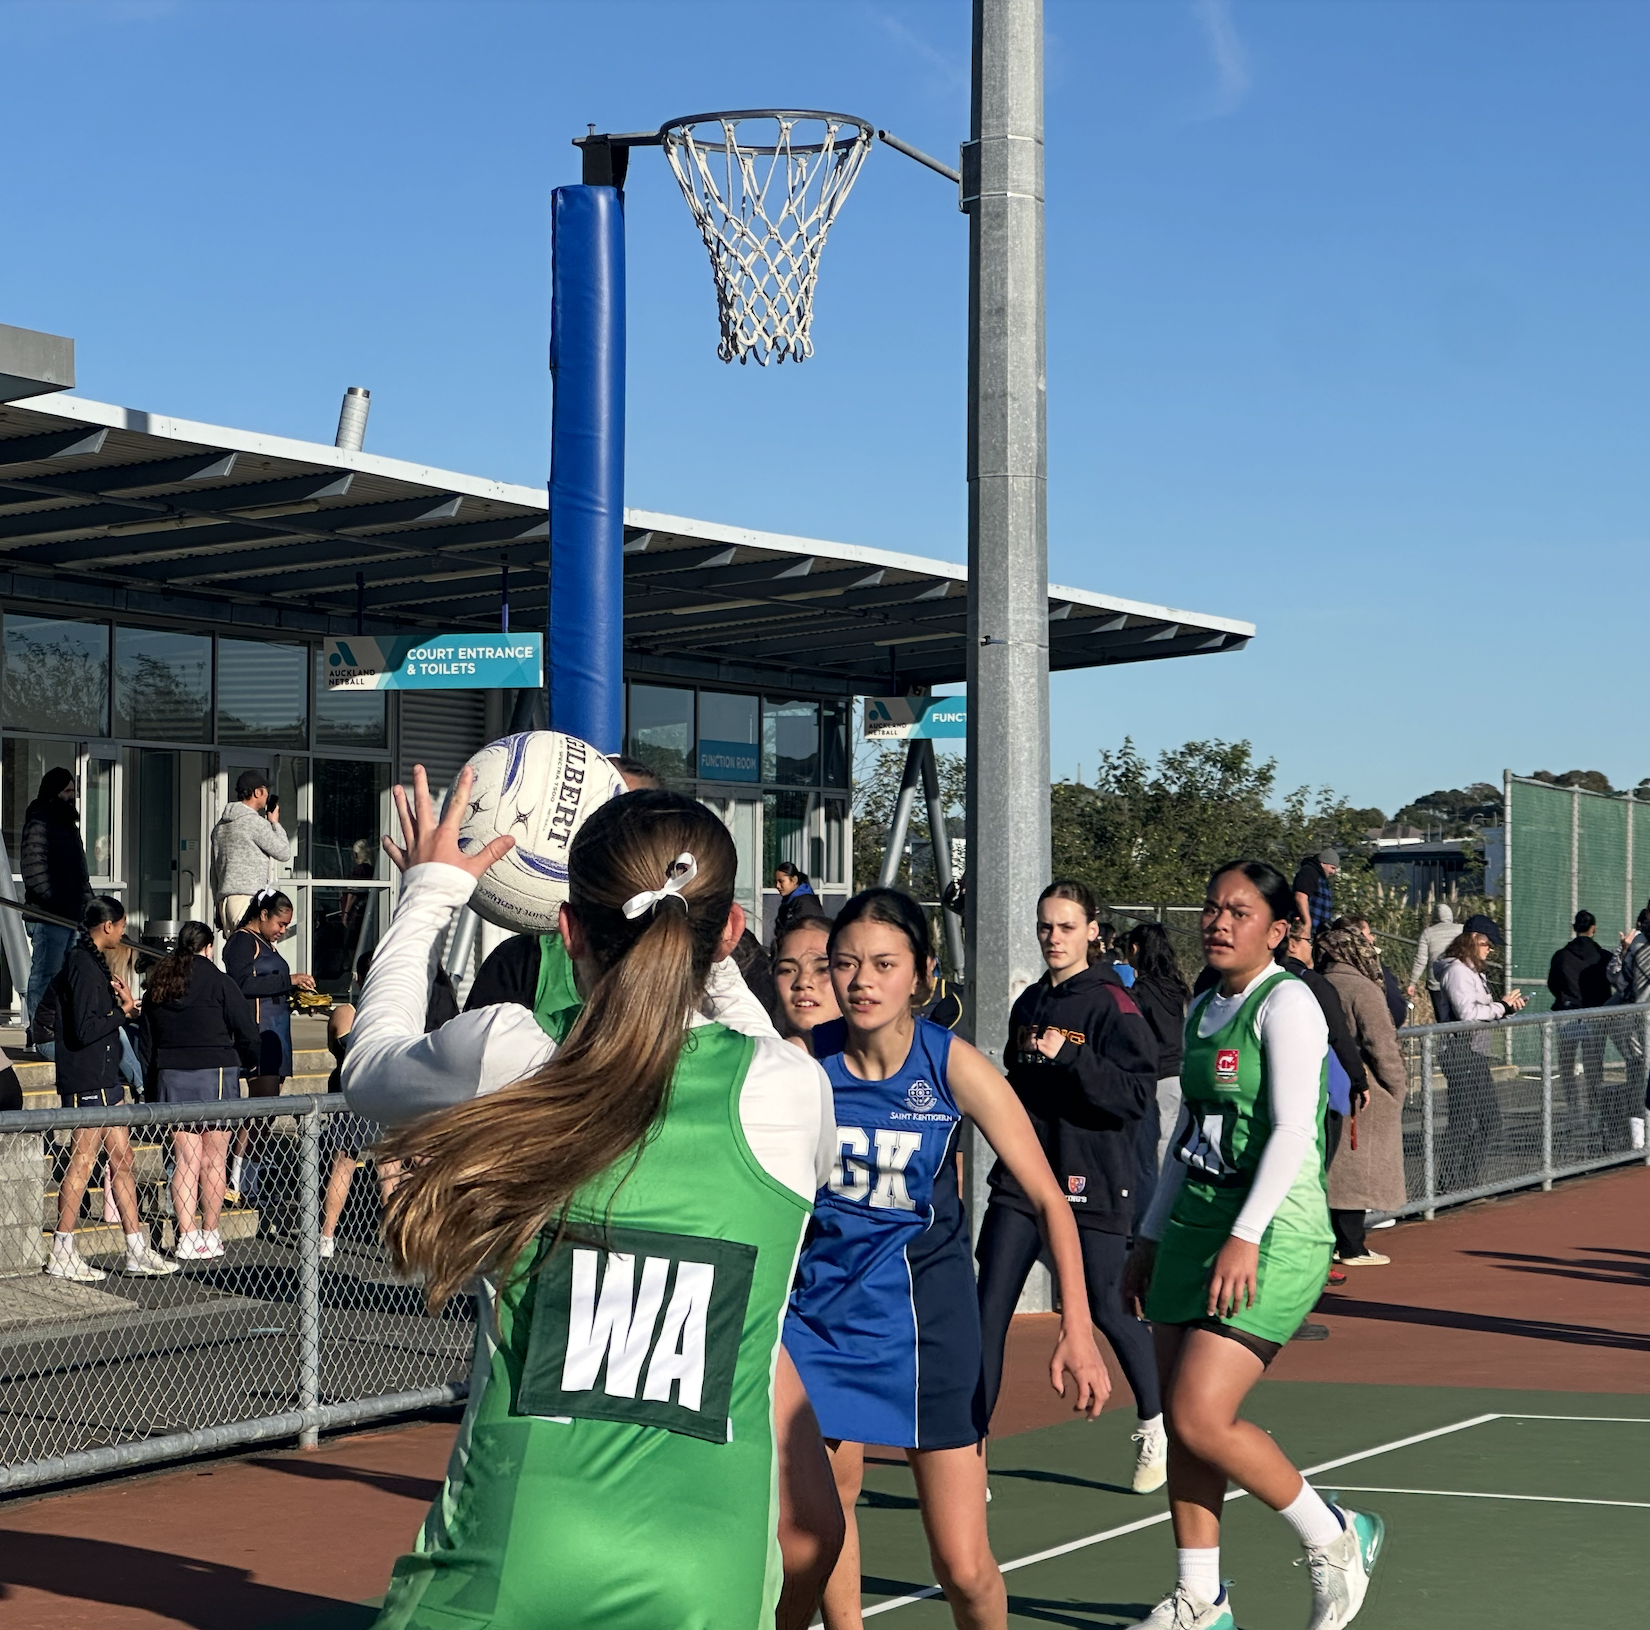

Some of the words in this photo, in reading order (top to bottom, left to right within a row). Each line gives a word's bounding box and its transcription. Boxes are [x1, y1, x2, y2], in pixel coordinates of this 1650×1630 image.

[407, 647, 455, 661] COURT
[458, 646, 534, 660] ENTRANCE
[329, 669, 376, 677] AUCKLAND
[406, 663, 416, 676] &
[420, 662, 476, 675] TOILETS
[328, 678, 365, 686] NETBALL
[554, 750, 564, 782] SPECTRA
[701, 754, 735, 769] FUNCTION
[736, 756, 757, 770] ROOM
[547, 736, 587, 850] GILBERT
[890, 1112, 912, 1120] SAINT
[912, 1112, 952, 1121] KENTIGERN
[828, 1126, 922, 1211] GK
[561, 1248, 715, 1412] WA
